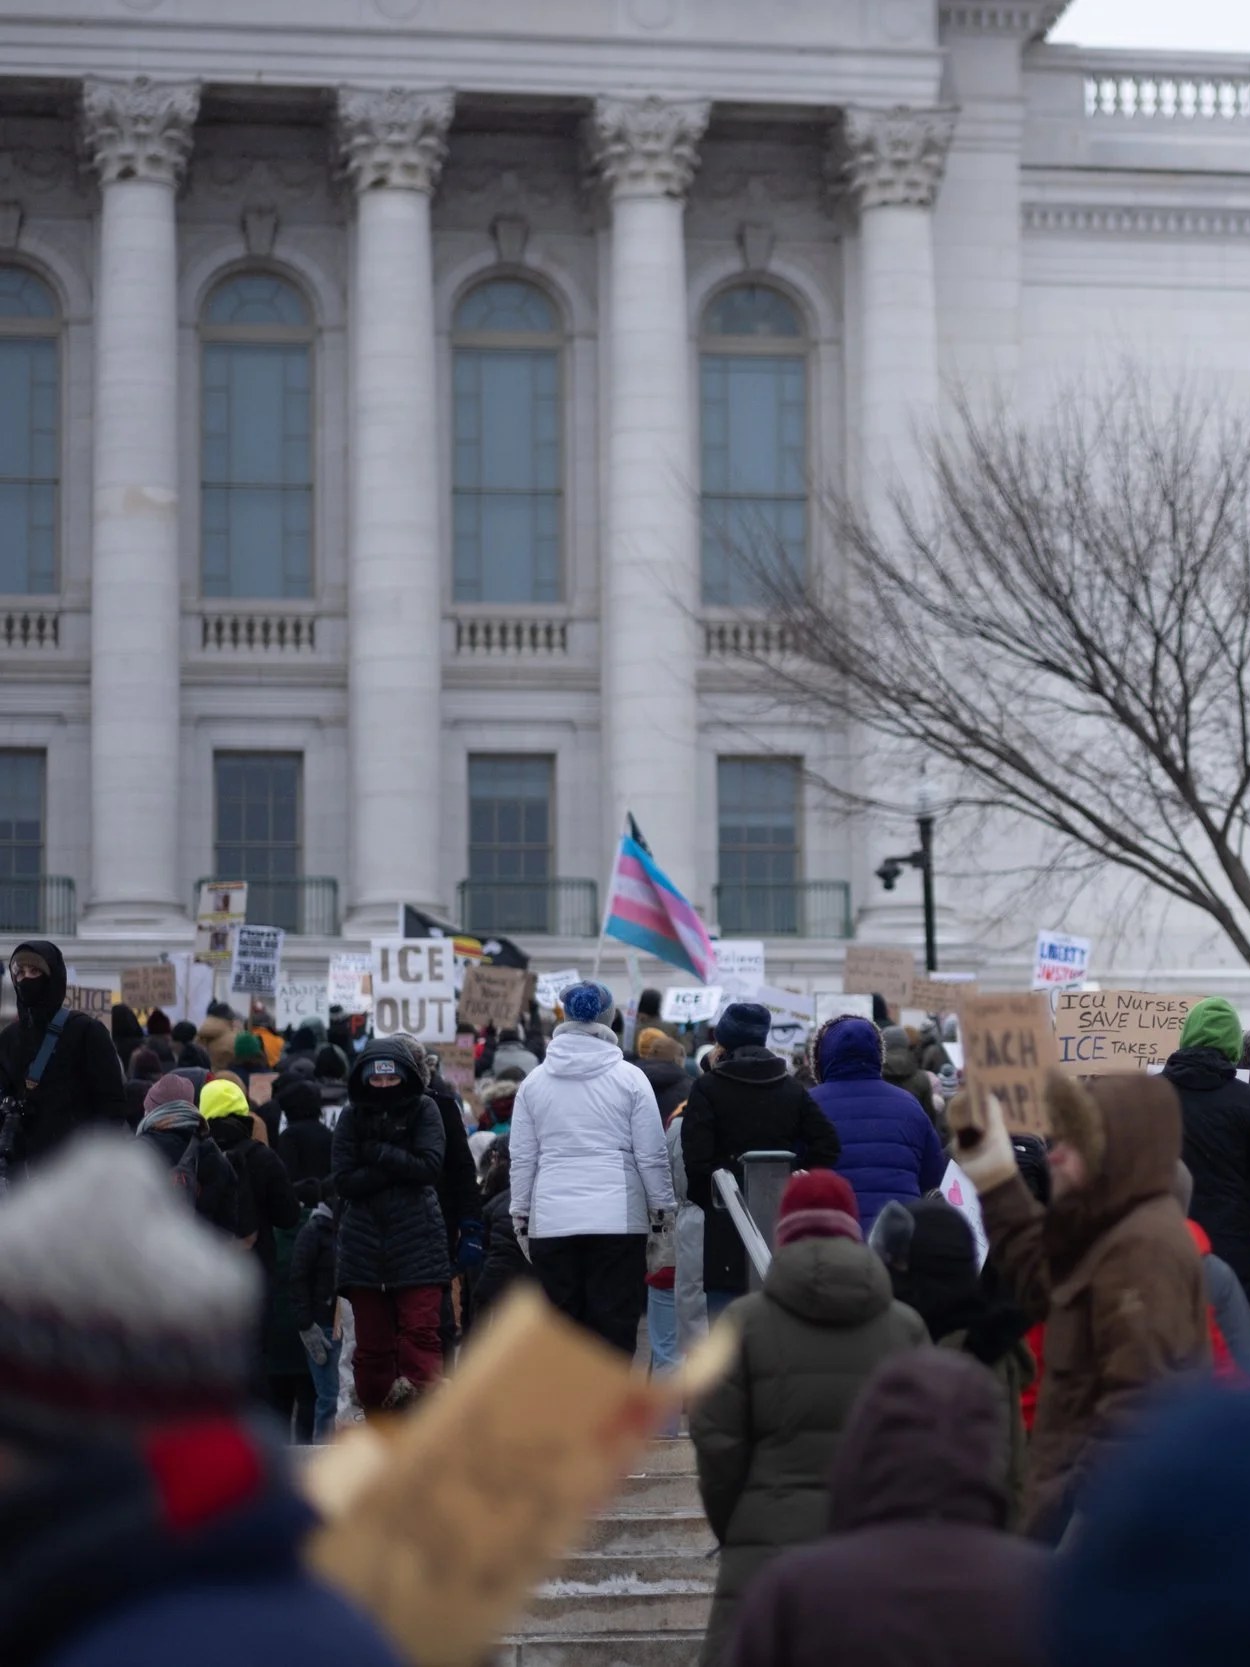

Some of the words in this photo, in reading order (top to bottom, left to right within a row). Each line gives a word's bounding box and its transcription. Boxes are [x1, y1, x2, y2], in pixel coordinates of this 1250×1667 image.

[380, 945, 444, 982] ICE
[676, 993, 702, 1004] ICE
[1061, 994, 1106, 1010] ICU
[376, 996, 452, 1034] OUT
[1078, 1011, 1130, 1029] SAVE
[1138, 1014, 1186, 1031] LIVES
[1058, 1036, 1107, 1062] ICE
[1111, 1041, 1159, 1056] TAKES
